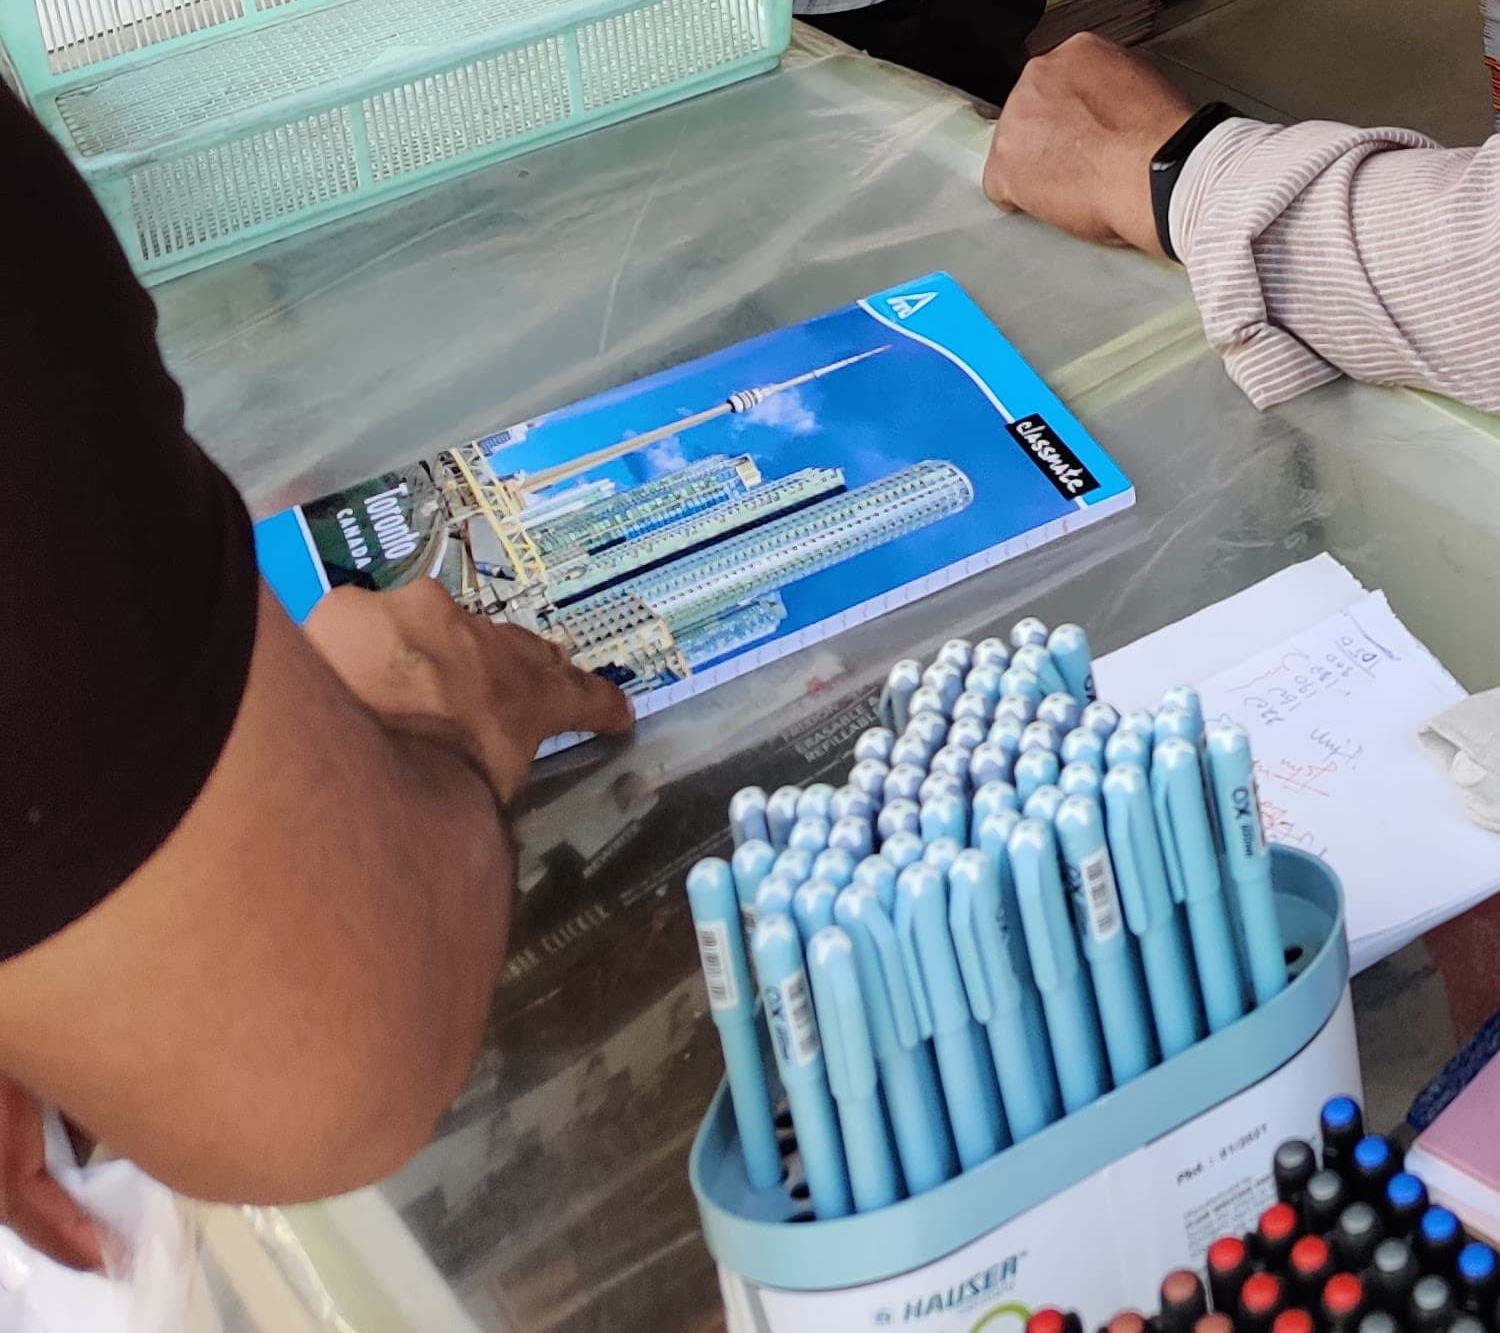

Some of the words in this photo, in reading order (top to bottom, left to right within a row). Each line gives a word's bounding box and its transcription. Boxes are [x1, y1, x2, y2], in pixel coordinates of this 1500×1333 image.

[1015, 419, 1086, 498] classmate
[334, 506, 374, 572] CANADA
[362, 481, 419, 565] Toronto
[1232, 785, 1251, 817] OX
[903, 1250, 1020, 1321] HAUSER
